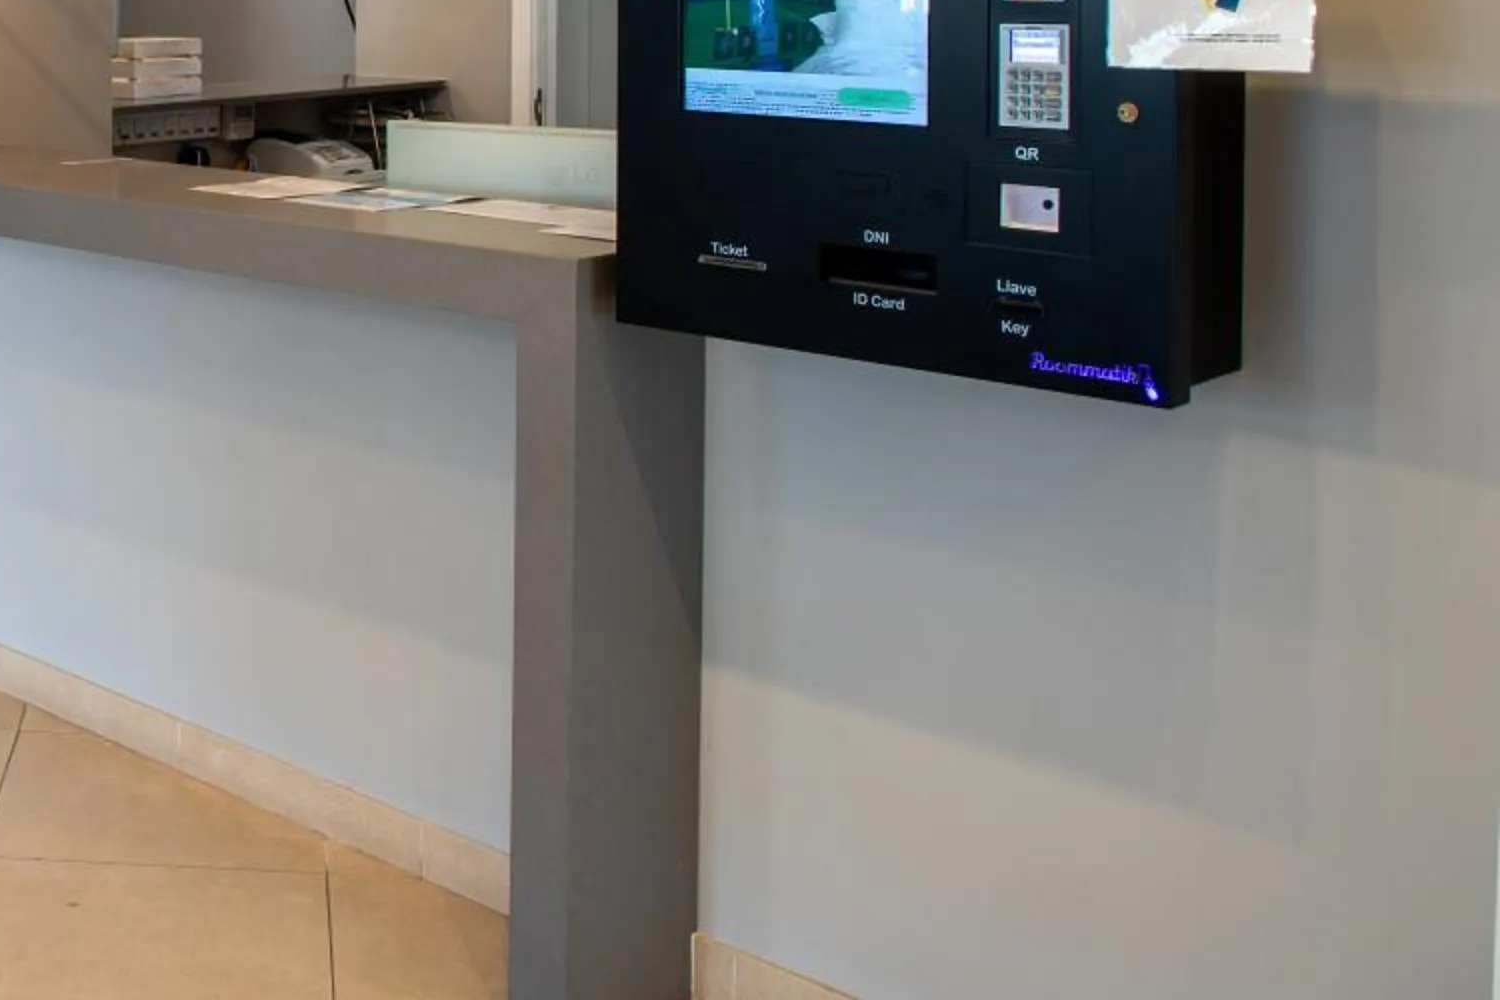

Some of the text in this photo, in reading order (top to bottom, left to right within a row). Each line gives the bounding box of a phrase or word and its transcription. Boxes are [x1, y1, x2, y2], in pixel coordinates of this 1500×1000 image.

[1015, 146, 1039, 161] QR
[863, 229, 889, 244] DNI
[710, 241, 748, 257] Ticket
[996, 279, 1037, 296] Llave
[853, 292, 905, 311] ID Card
[1001, 320, 1030, 337] Key
